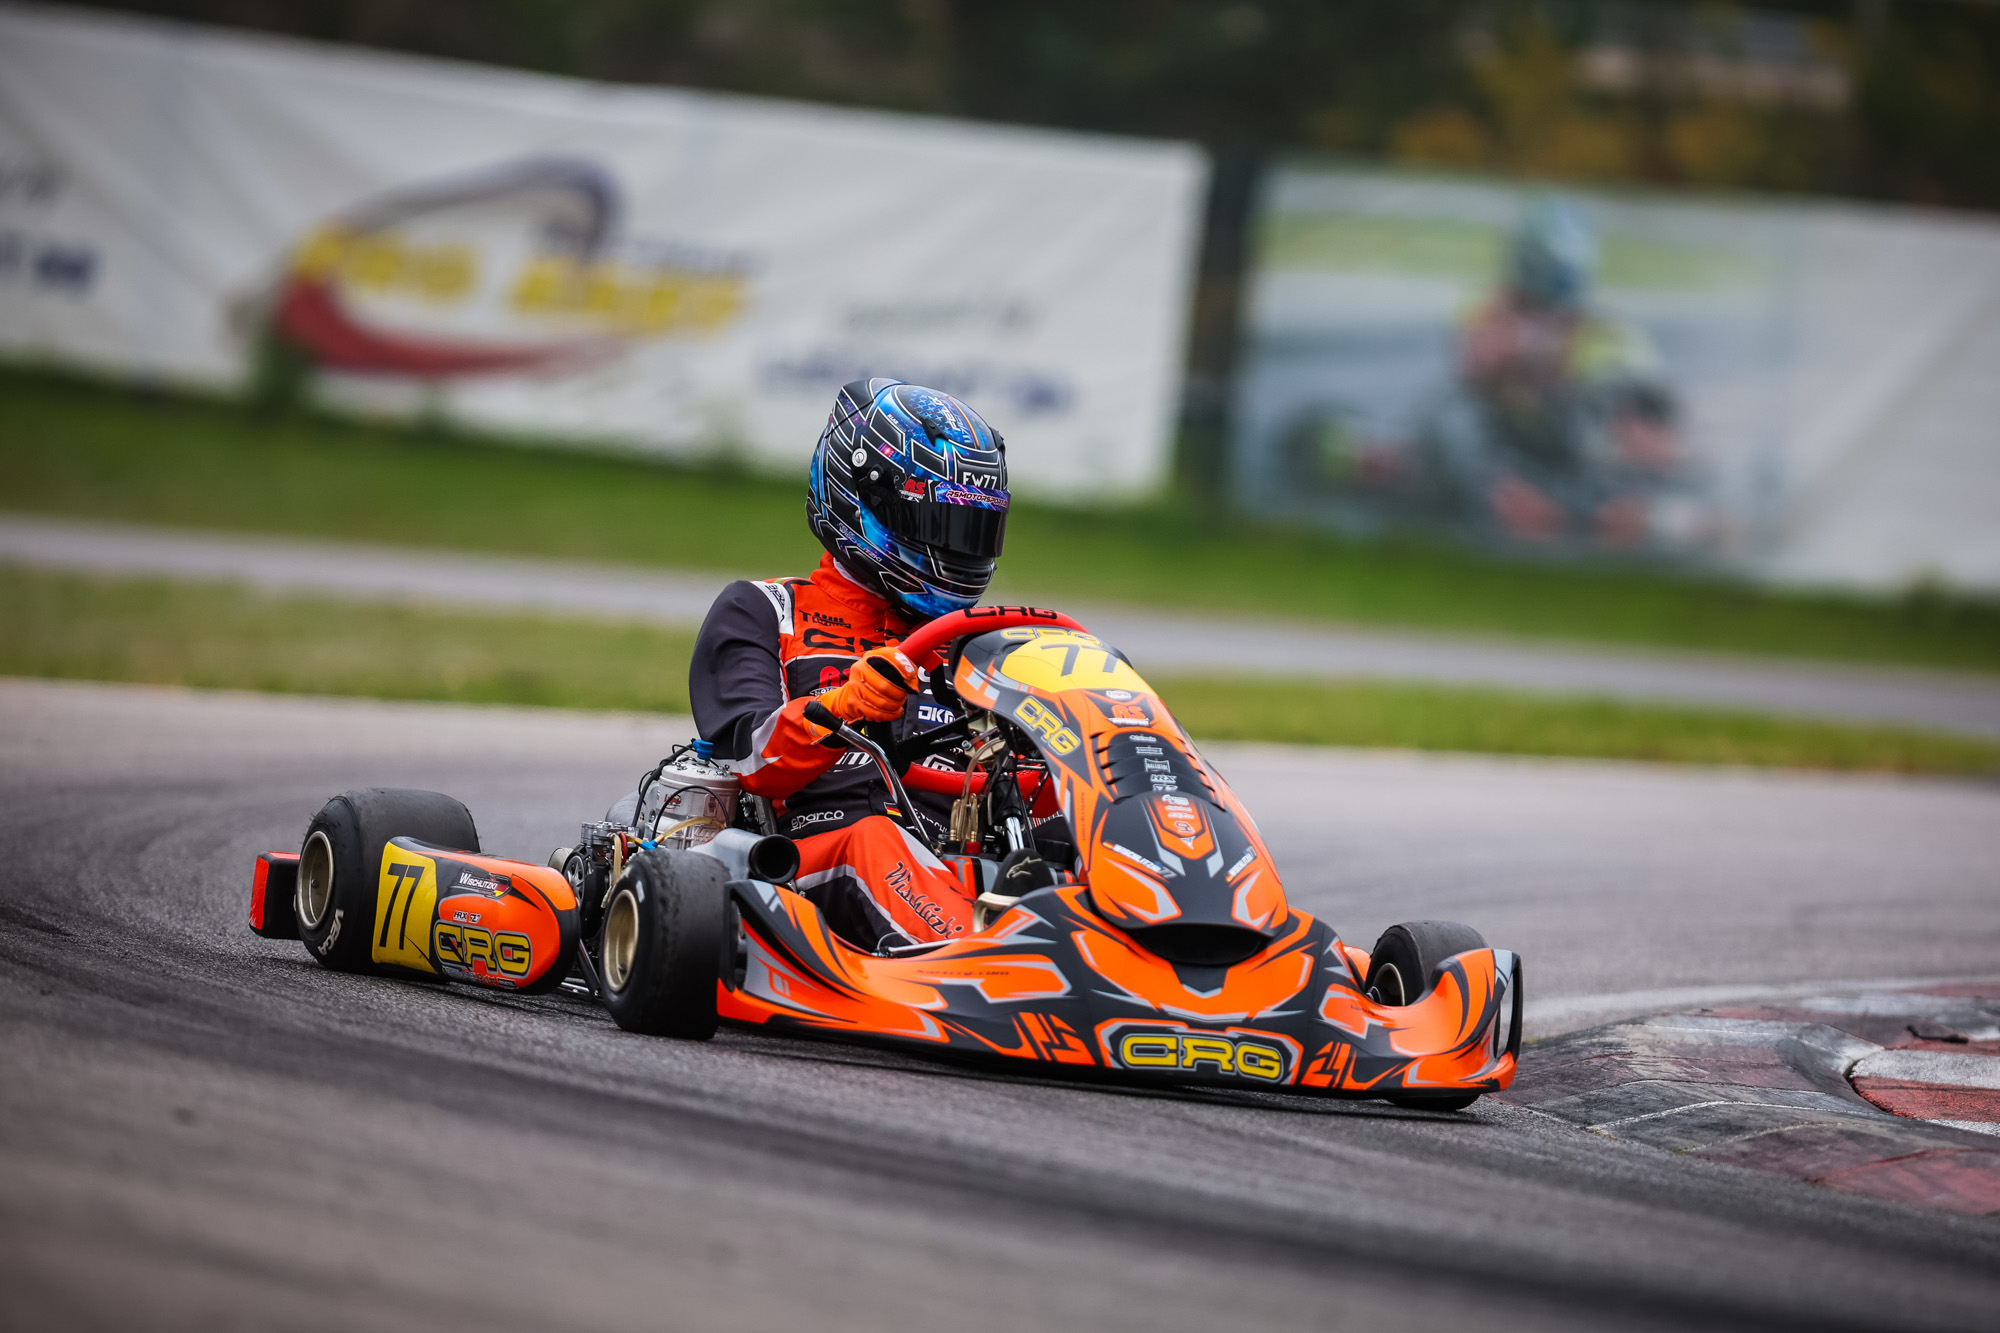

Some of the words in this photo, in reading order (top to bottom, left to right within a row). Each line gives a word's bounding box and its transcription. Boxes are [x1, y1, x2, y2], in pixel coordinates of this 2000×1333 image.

[904, 479, 926, 494] RS
[963, 605, 1058, 620] CRG
[1040, 643, 1120, 677] 77
[1013, 695, 1081, 756] CRG
[1111, 704, 1147, 719] RS
[790, 809, 845, 831] sparco
[379, 862, 426, 951] 77
[433, 920, 533, 979] CRG
[1120, 1033, 1285, 1083] CRG
